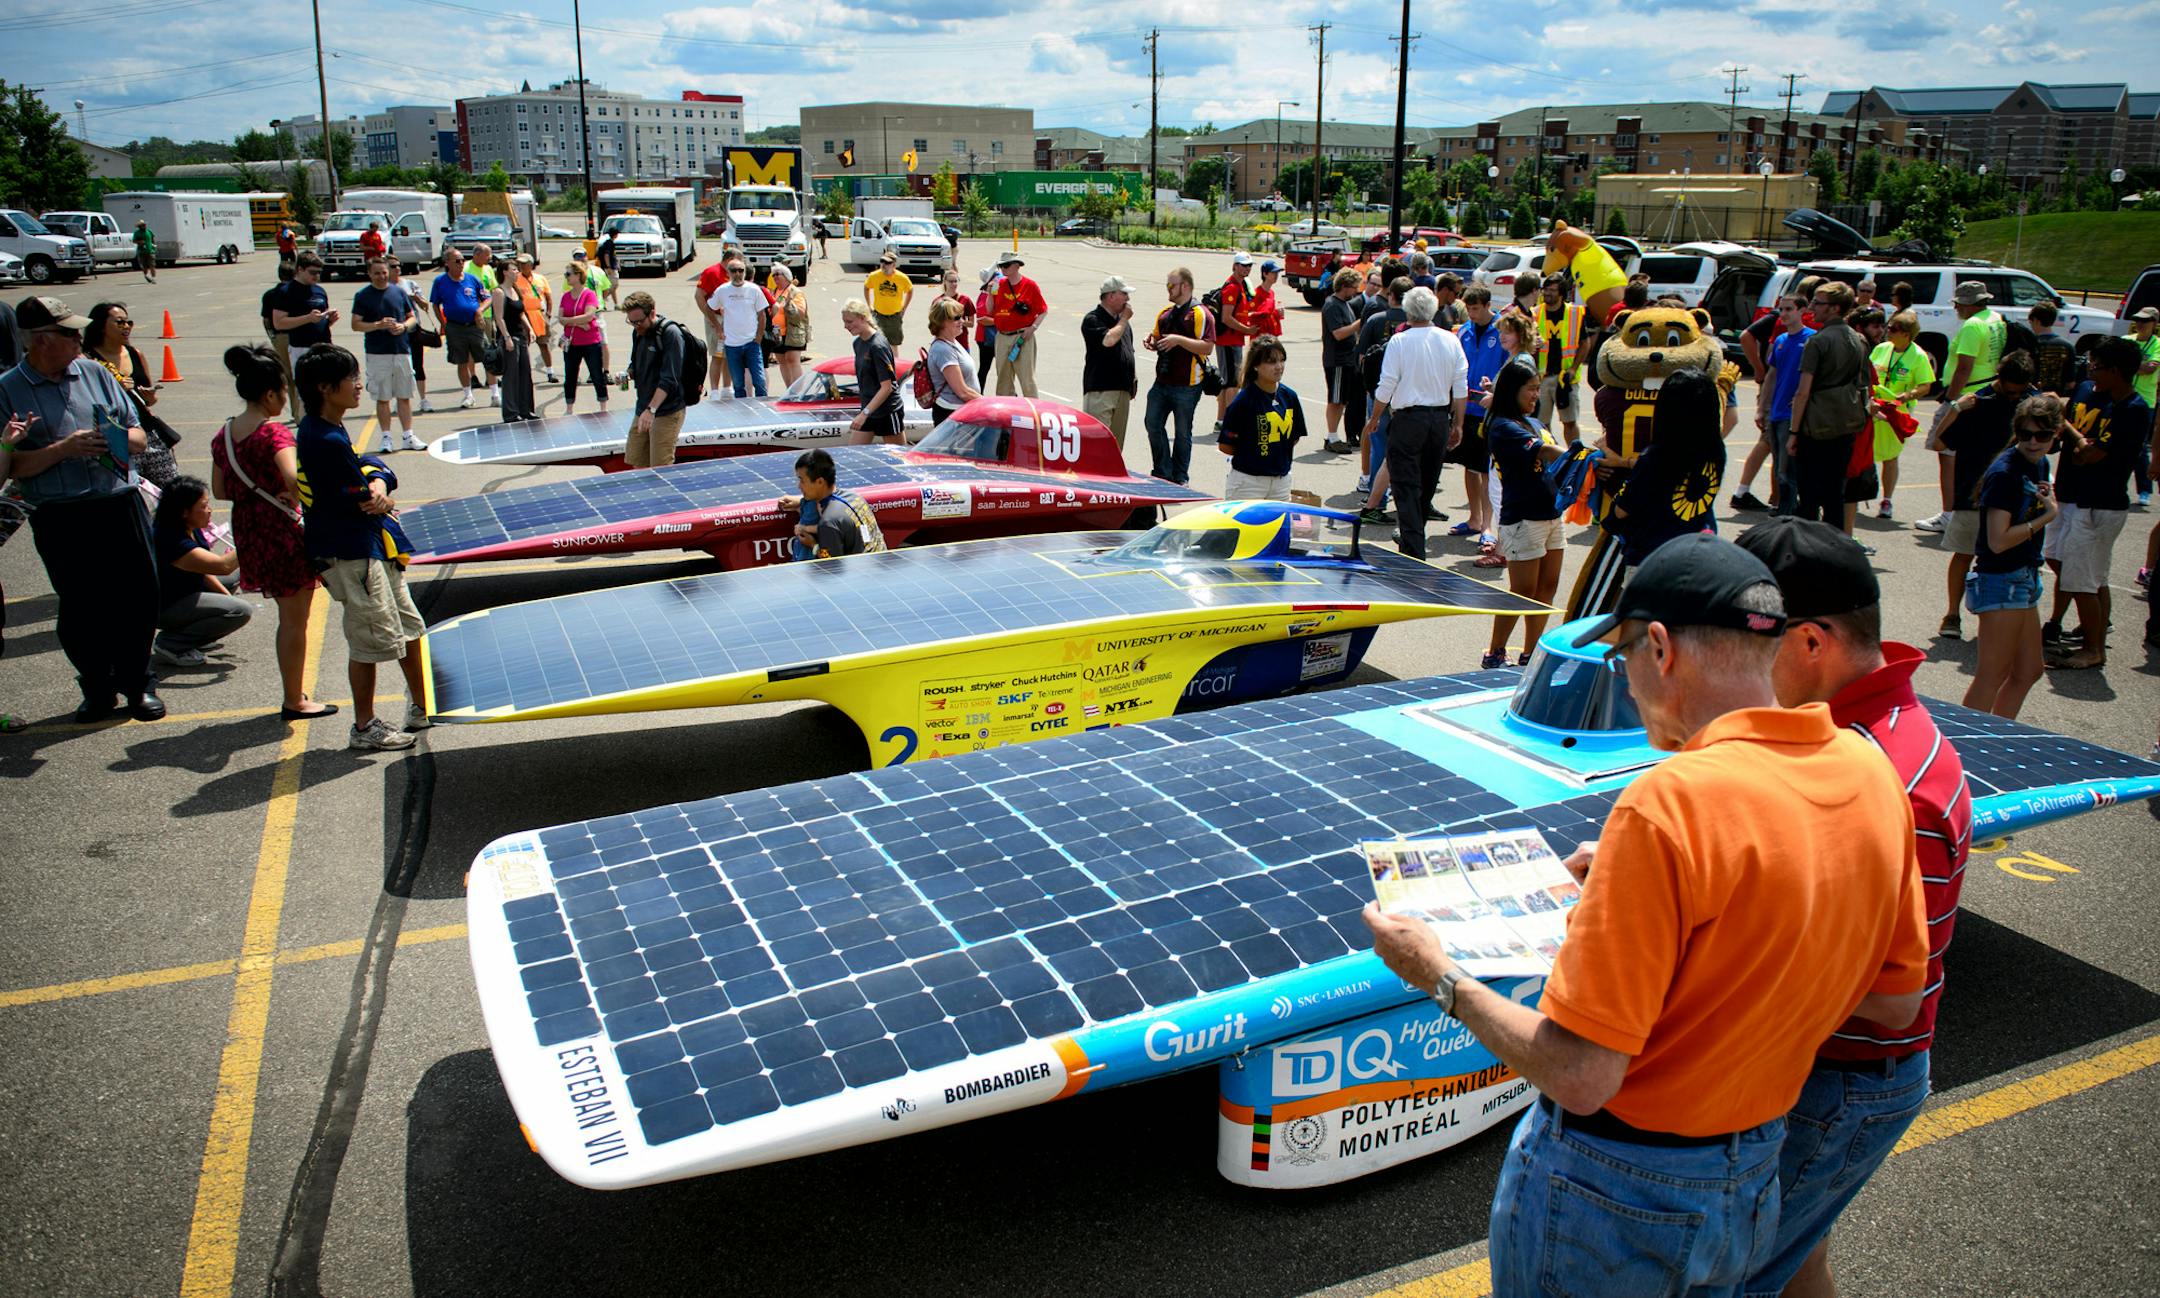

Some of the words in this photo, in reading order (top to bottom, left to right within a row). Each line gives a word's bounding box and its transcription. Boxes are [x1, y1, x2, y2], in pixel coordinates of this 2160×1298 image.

[729, 151, 795, 185] M
[1035, 183, 1114, 194] EVERGREN
[1311, 255, 1318, 268] 9
[2069, 314, 2081, 334] 2
[809, 427, 842, 437] GSB
[1265, 408, 1294, 443] M
[729, 431, 768, 439] DELTA
[1040, 411, 1081, 463] 35
[1040, 492, 1056, 504] CAT
[1099, 494, 1131, 504] DELTA
[700, 508, 746, 519] UNIVERSITY
[714, 517, 741, 526] Driven
[753, 512, 788, 521] Discover
[653, 523, 692, 535] Altium
[552, 533, 625, 548] SUNPOWER
[1097, 632, 1178, 652] UNIVERSITY
[1178, 630, 1198, 640] OF
[1199, 623, 1267, 637] MICHIGAN
[1083, 661, 1129, 681] QATAR
[970, 681, 1006, 692] stryker
[1011, 675, 1039, 687] Chuck
[1040, 671, 1078, 683] Hutchins
[1099, 683, 1131, 695] MICHIGAN
[1131, 671, 1173, 687] ENGINEERING
[924, 686, 964, 696] ROUSH
[997, 691, 1034, 705] SKF
[1105, 697, 1140, 714] NYK
[965, 712, 991, 726] IBM
[1003, 712, 1035, 721] inmarsat
[925, 720, 956, 729] vector
[1031, 717, 1069, 732] CYTEC
[942, 733, 971, 741] Exa
[879, 726, 918, 767] 2
[1144, 1012, 1249, 1062] Gurit
[1280, 1051, 1337, 1087] TD
[557, 1044, 618, 1130] ESTEBAN
[944, 1062, 1052, 1105] BOMBARDIER
[1340, 1060, 1511, 1130] POLYTECHNIQUE
[1338, 1108, 1461, 1159] MONTRÉAL
[584, 1129, 630, 1166] VII
